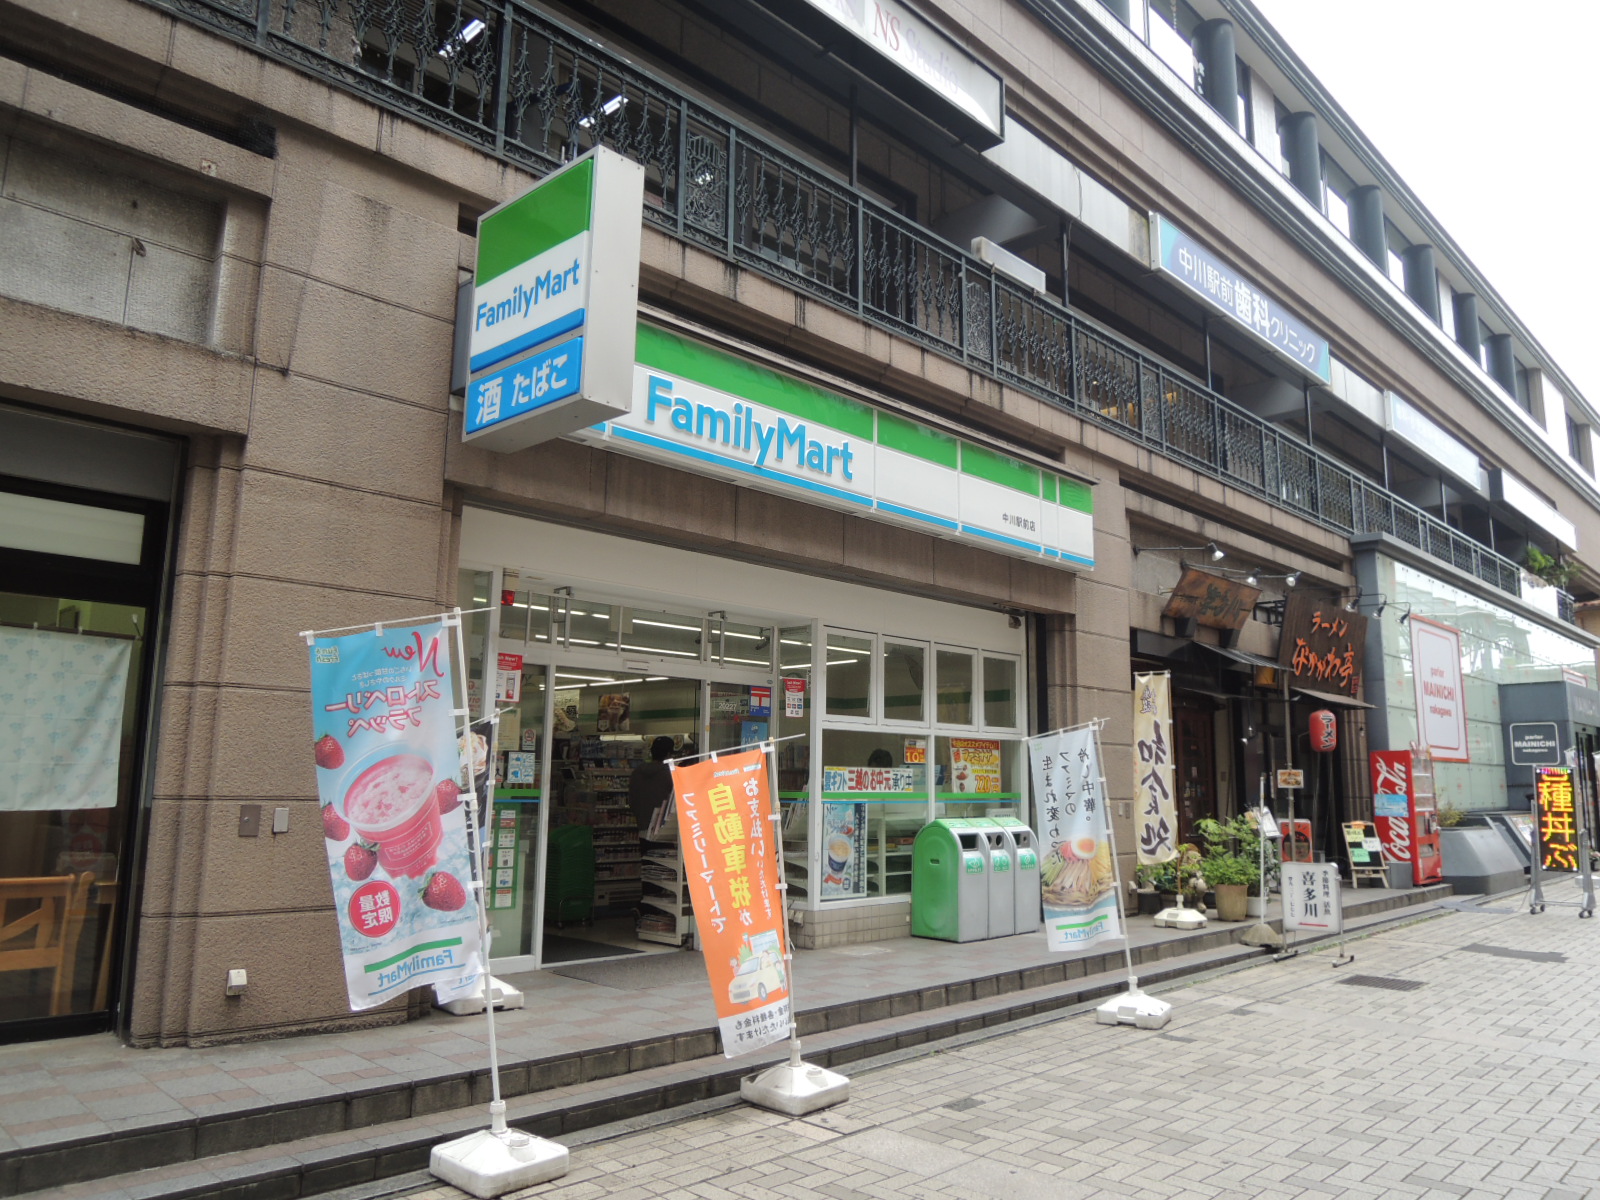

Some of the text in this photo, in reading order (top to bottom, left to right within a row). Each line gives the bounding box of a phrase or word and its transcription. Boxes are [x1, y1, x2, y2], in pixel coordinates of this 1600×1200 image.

[873, 1, 900, 52] NS
[475, 257, 580, 332] FamilyMart
[1178, 246, 1316, 363] 中川駅前歯科クリニック
[475, 353, 568, 425] 酒 たばこ
[645, 374, 854, 481] FamilyMart
[1002, 511, 1036, 532] 中川駅前店
[1311, 611, 1349, 638] ラーメン
[1423, 680, 1455, 701] MAINICHI
[1320, 713, 1334, 750] ラーメン
[1514, 740, 1556, 748] MAINICHI
[848, 768, 892, 791] 三越のお中元
[892, 773, 912, 791] 承り中
[1301, 871, 1318, 918] 喜多川
